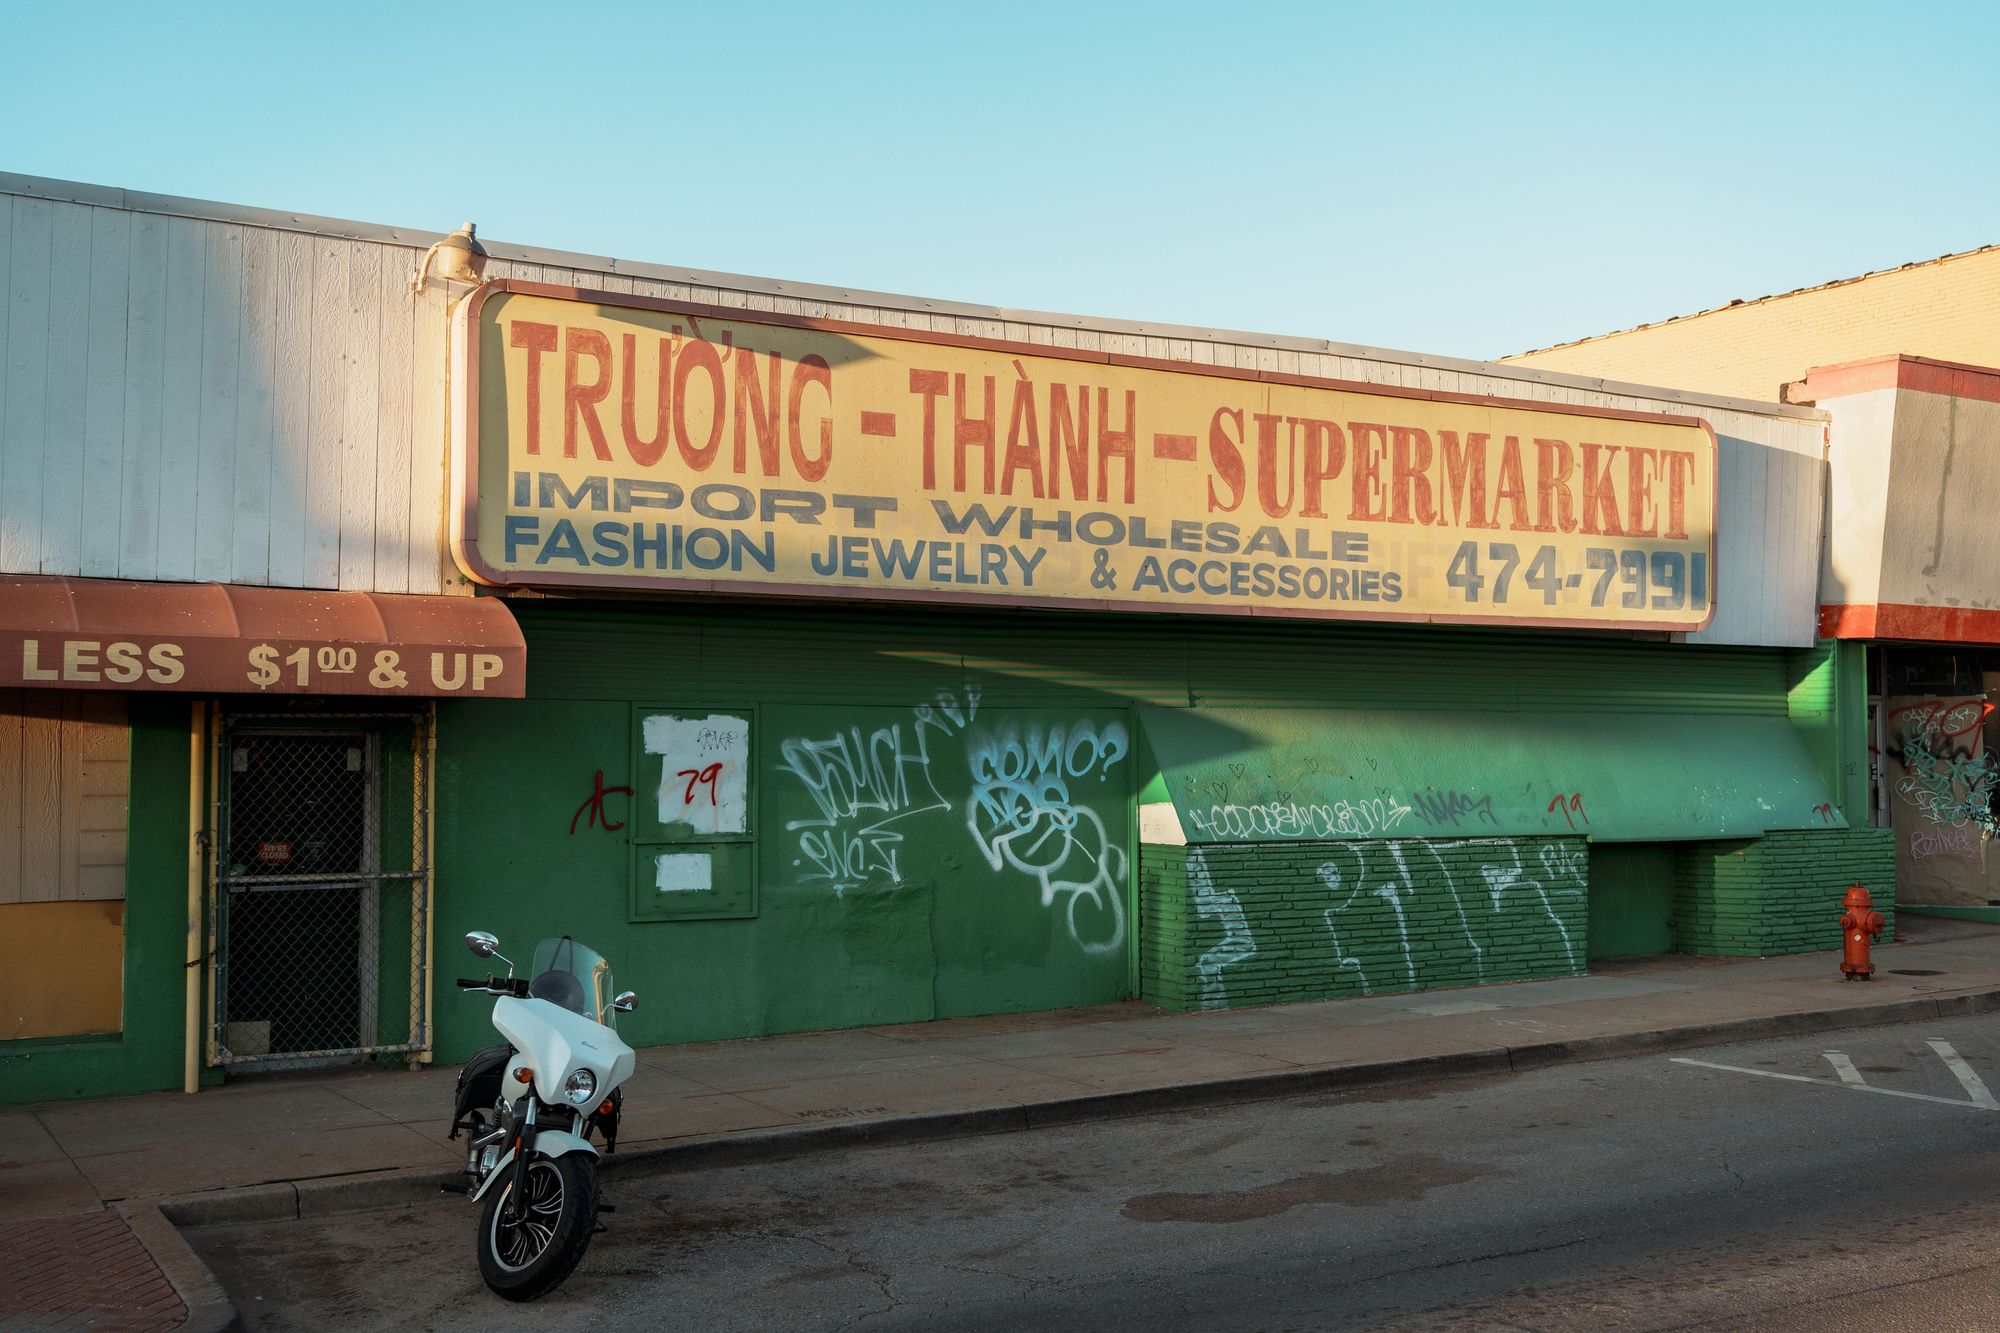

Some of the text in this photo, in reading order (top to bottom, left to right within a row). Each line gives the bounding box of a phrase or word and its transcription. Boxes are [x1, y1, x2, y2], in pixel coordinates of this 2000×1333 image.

[909, 360, 1136, 504] THÀNH
[1207, 406, 1695, 541] SUPERMARKET
[513, 471, 1369, 563] IMPORT WHOLESALE
[504, 515, 775, 573] FASHION
[811, 535, 1047, 587] JEWELRY
[1090, 547, 1117, 591] &
[1132, 555, 1403, 603] ACCESSORIES
[1445, 540, 1706, 612] 474-7991
[22, 639, 185, 684] LESS
[368, 650, 408, 689] &
[431, 652, 504, 691] UP
[677, 762, 723, 807] 79
[260, 851, 290, 860] CLOSED
